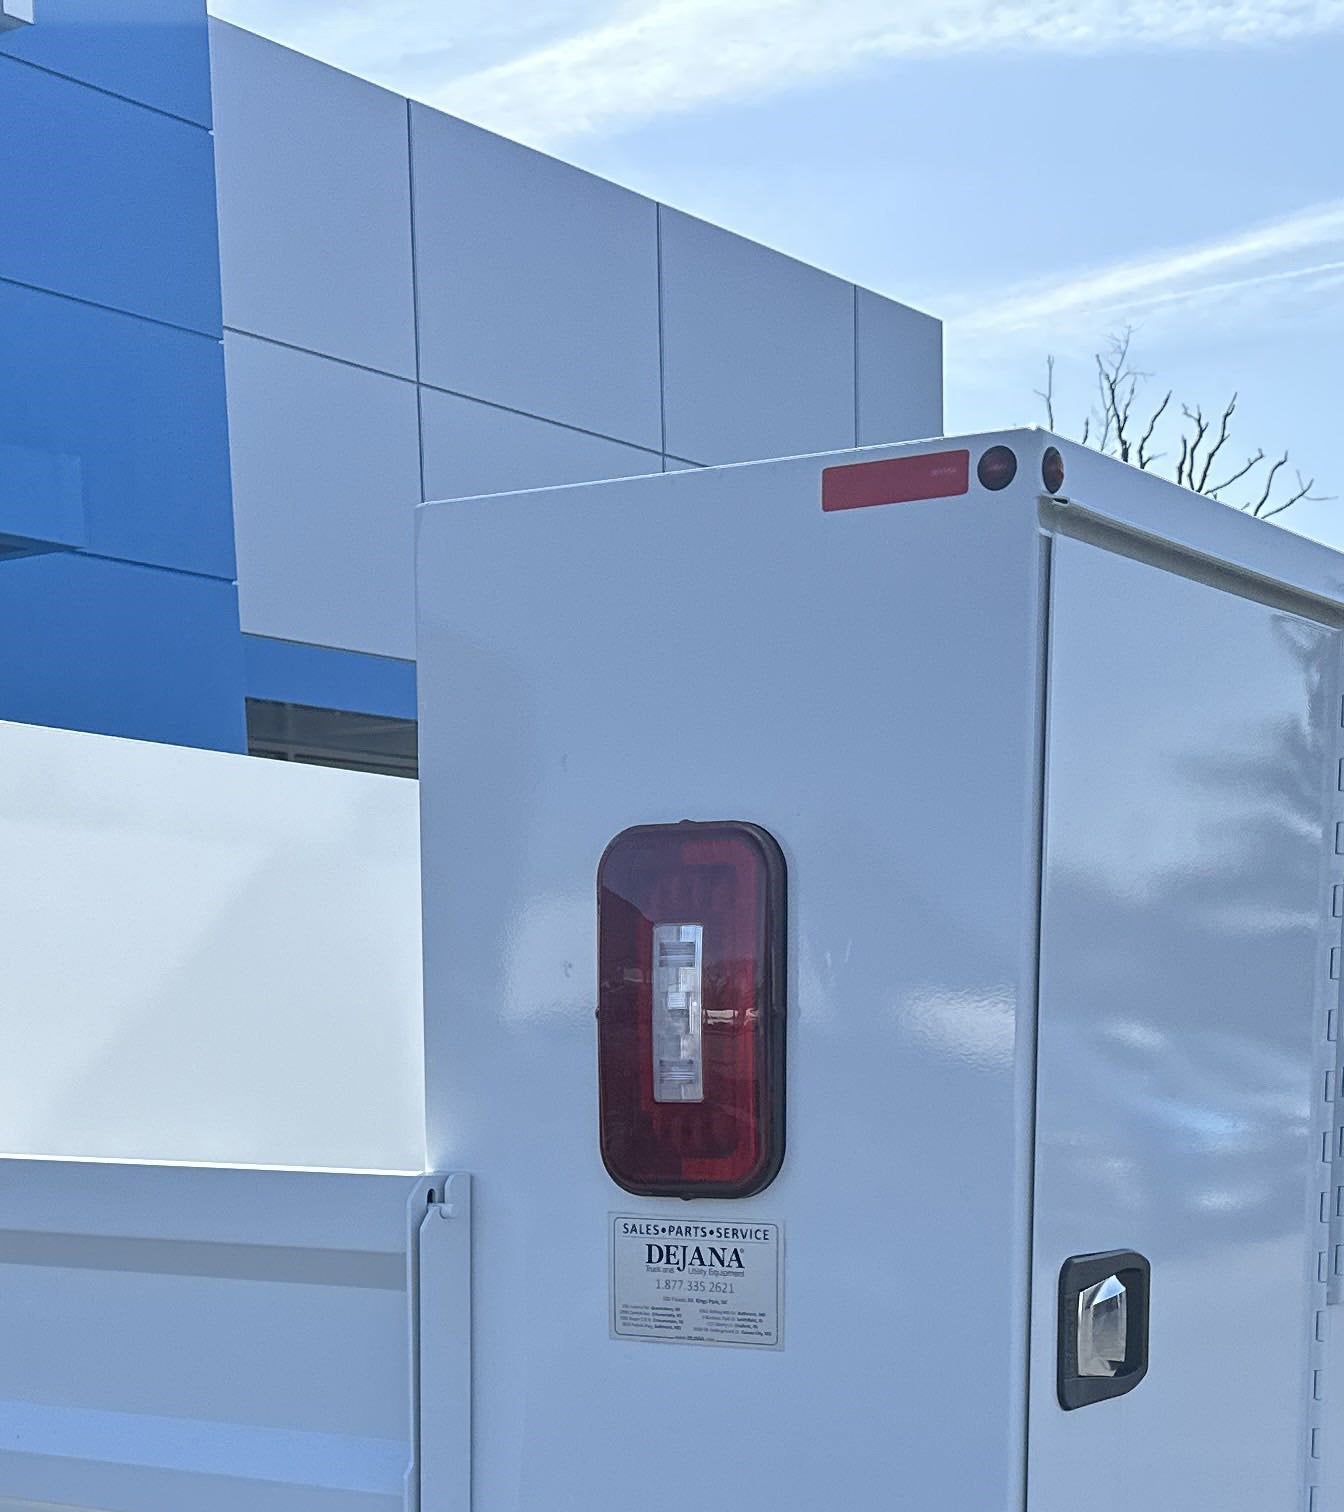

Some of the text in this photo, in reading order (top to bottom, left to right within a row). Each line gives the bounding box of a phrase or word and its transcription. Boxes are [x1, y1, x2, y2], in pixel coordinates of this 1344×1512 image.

[622, 1222, 770, 1241] SALES PARTS SERVICE
[645, 1243, 745, 1272] DEJANA
